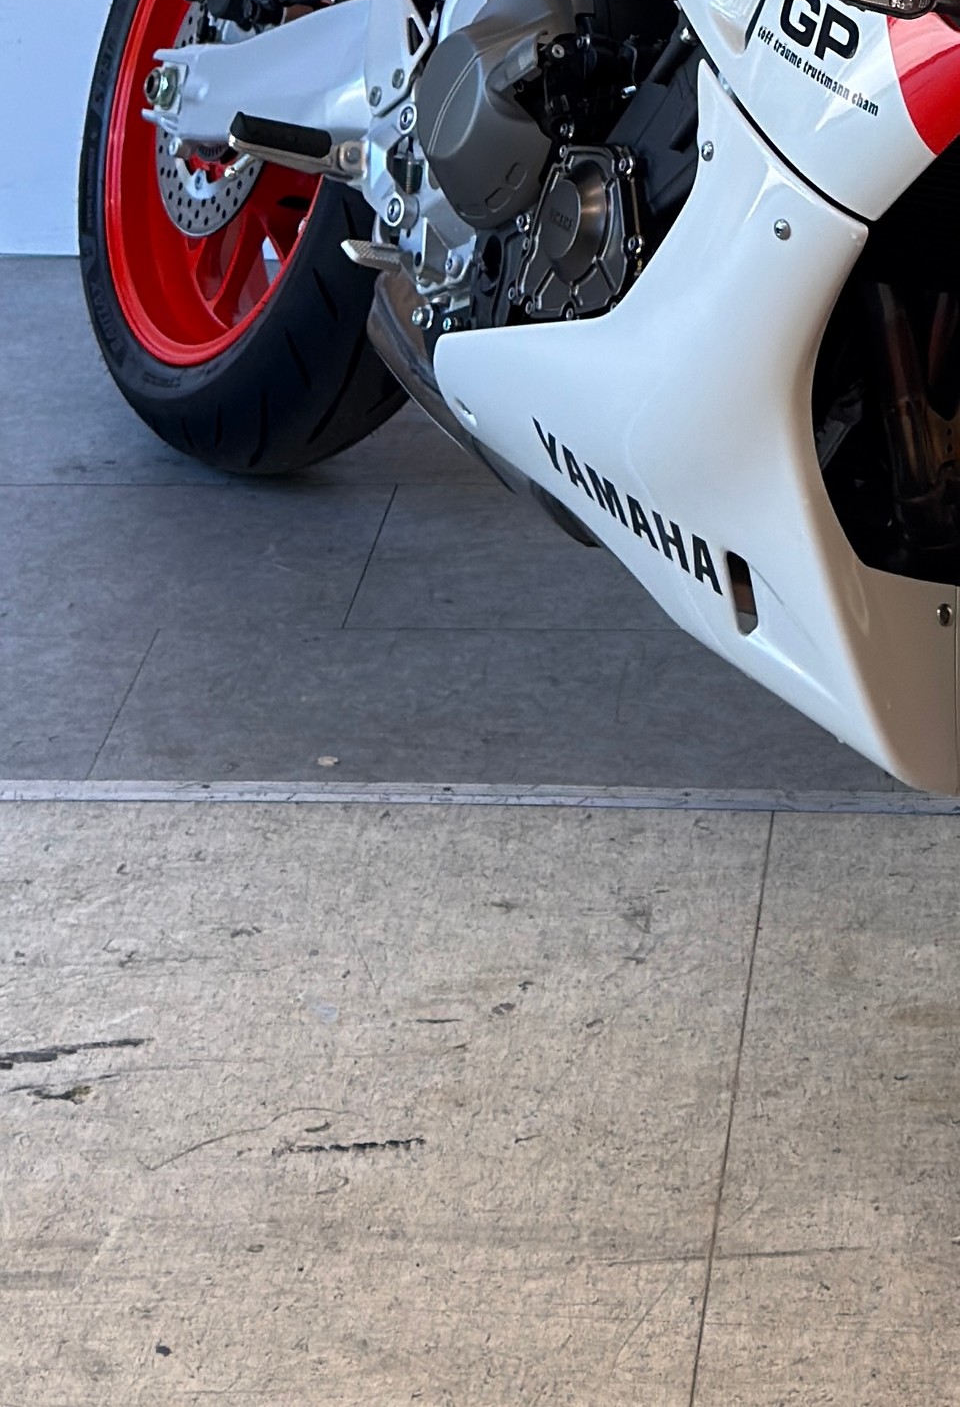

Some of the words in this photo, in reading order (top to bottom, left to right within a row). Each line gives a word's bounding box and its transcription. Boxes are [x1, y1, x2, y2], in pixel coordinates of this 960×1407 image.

[803, 60, 850, 100] truttmann
[851, 92, 879, 117] cham
[532, 416, 723, 596] YAMAHA
